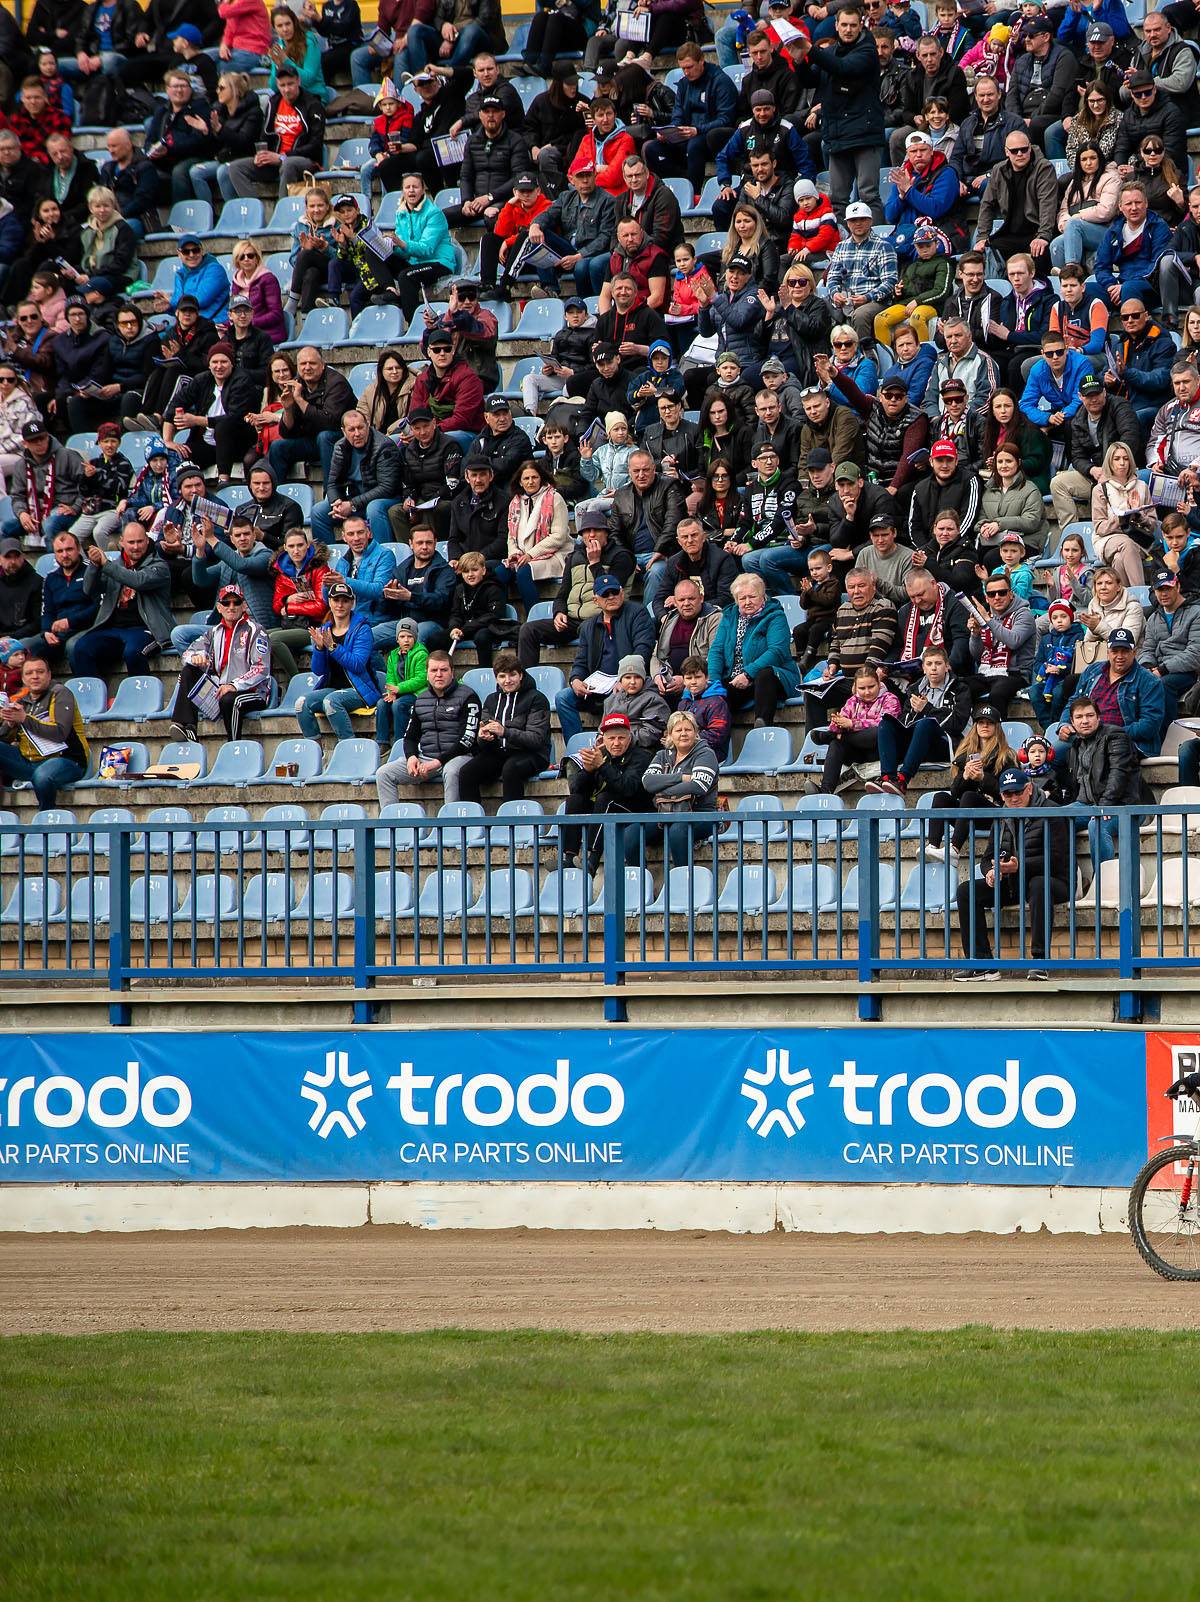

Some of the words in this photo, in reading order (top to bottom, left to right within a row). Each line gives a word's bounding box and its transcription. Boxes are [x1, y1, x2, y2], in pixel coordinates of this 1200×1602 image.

[762, 731, 775, 742] 12
[625, 870, 638, 881] 12
[0, 1062, 192, 1127] rodo
[386, 1060, 624, 1126] trodo
[829, 1060, 1076, 1128] trodo
[26, 1143, 99, 1164] PARTS
[105, 1143, 190, 1164] ONLINE
[399, 1142, 448, 1163] CAR
[454, 1142, 530, 1164] PARTS
[535, 1142, 623, 1163] ONLINE
[843, 1142, 894, 1164] CAR
[900, 1143, 979, 1165] PARTS
[984, 1144, 1075, 1167] ONLINE
